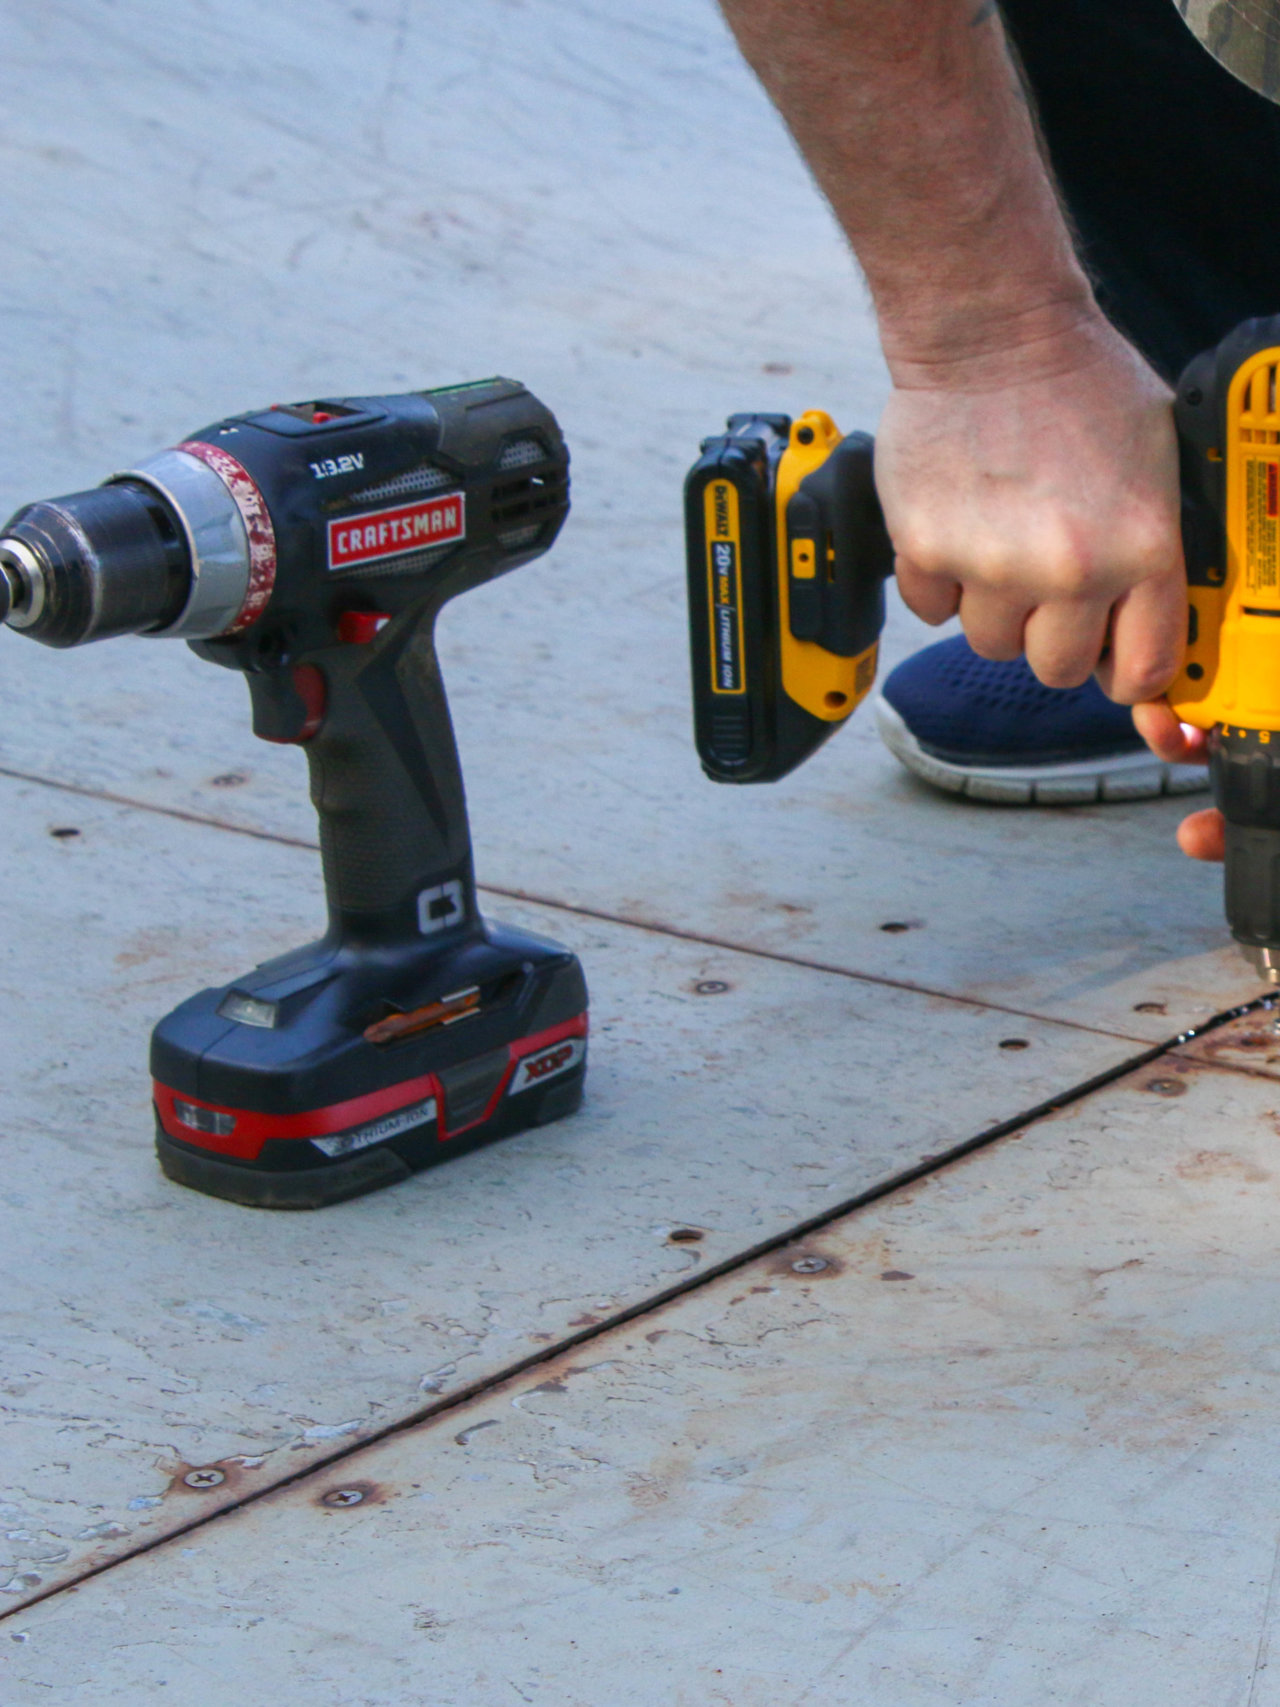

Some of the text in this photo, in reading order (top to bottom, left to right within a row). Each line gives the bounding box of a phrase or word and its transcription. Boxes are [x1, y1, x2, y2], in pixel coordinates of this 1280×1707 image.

[337, 506, 457, 554] CRAFTSMAN
[720, 609, 733, 662] LITHIUM
[722, 664, 733, 689] ION
[1259, 731, 1271, 744] 5
